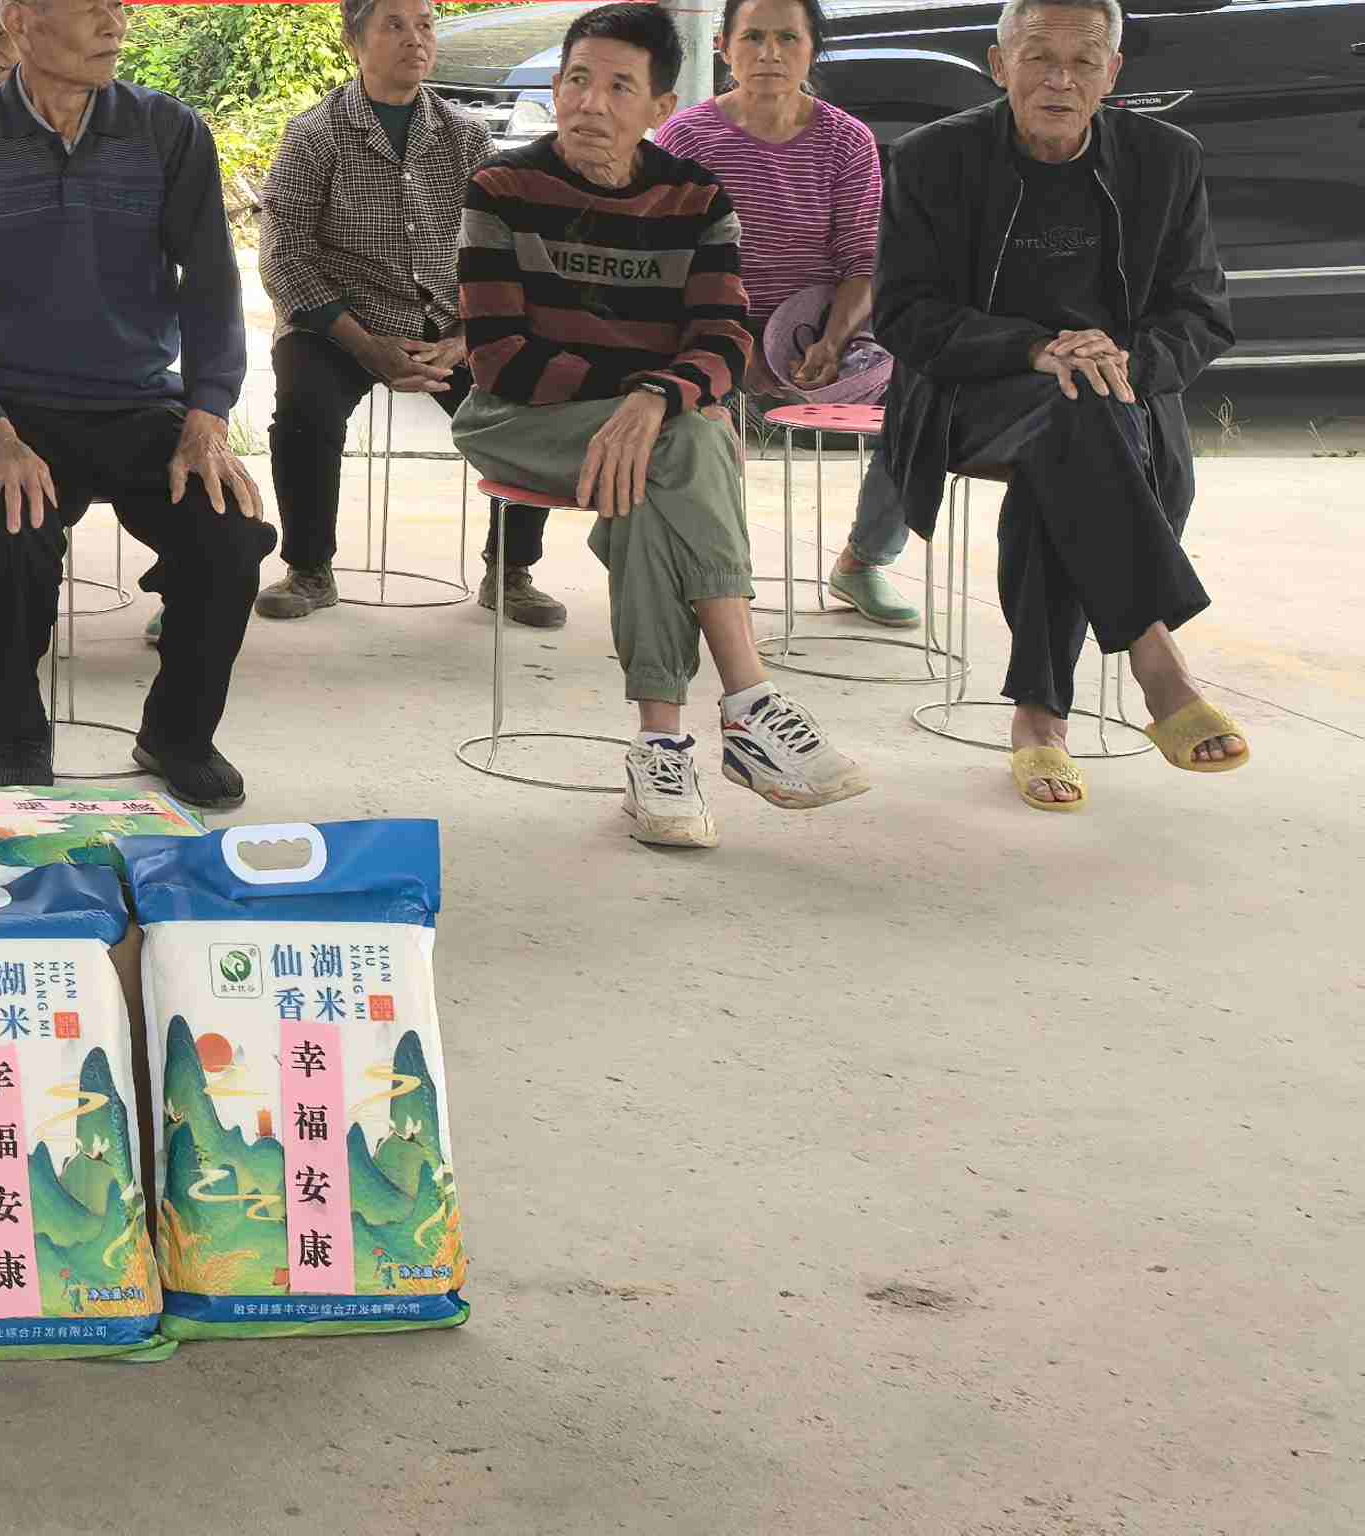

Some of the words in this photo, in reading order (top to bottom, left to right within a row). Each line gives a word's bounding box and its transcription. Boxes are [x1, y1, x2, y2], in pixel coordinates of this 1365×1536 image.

[49, 961, 60, 983] HU
[270, 944, 344, 978] 仙湖
[349, 944, 364, 995] XIANG
[364, 945, 376, 967] HU
[378, 945, 391, 982] XIAN
[33, 961, 48, 1011] XIANG
[63, 961, 77, 999] XIAN
[273, 987, 346, 1021] 香米
[291, 1040, 333, 1268] 幸福安康
